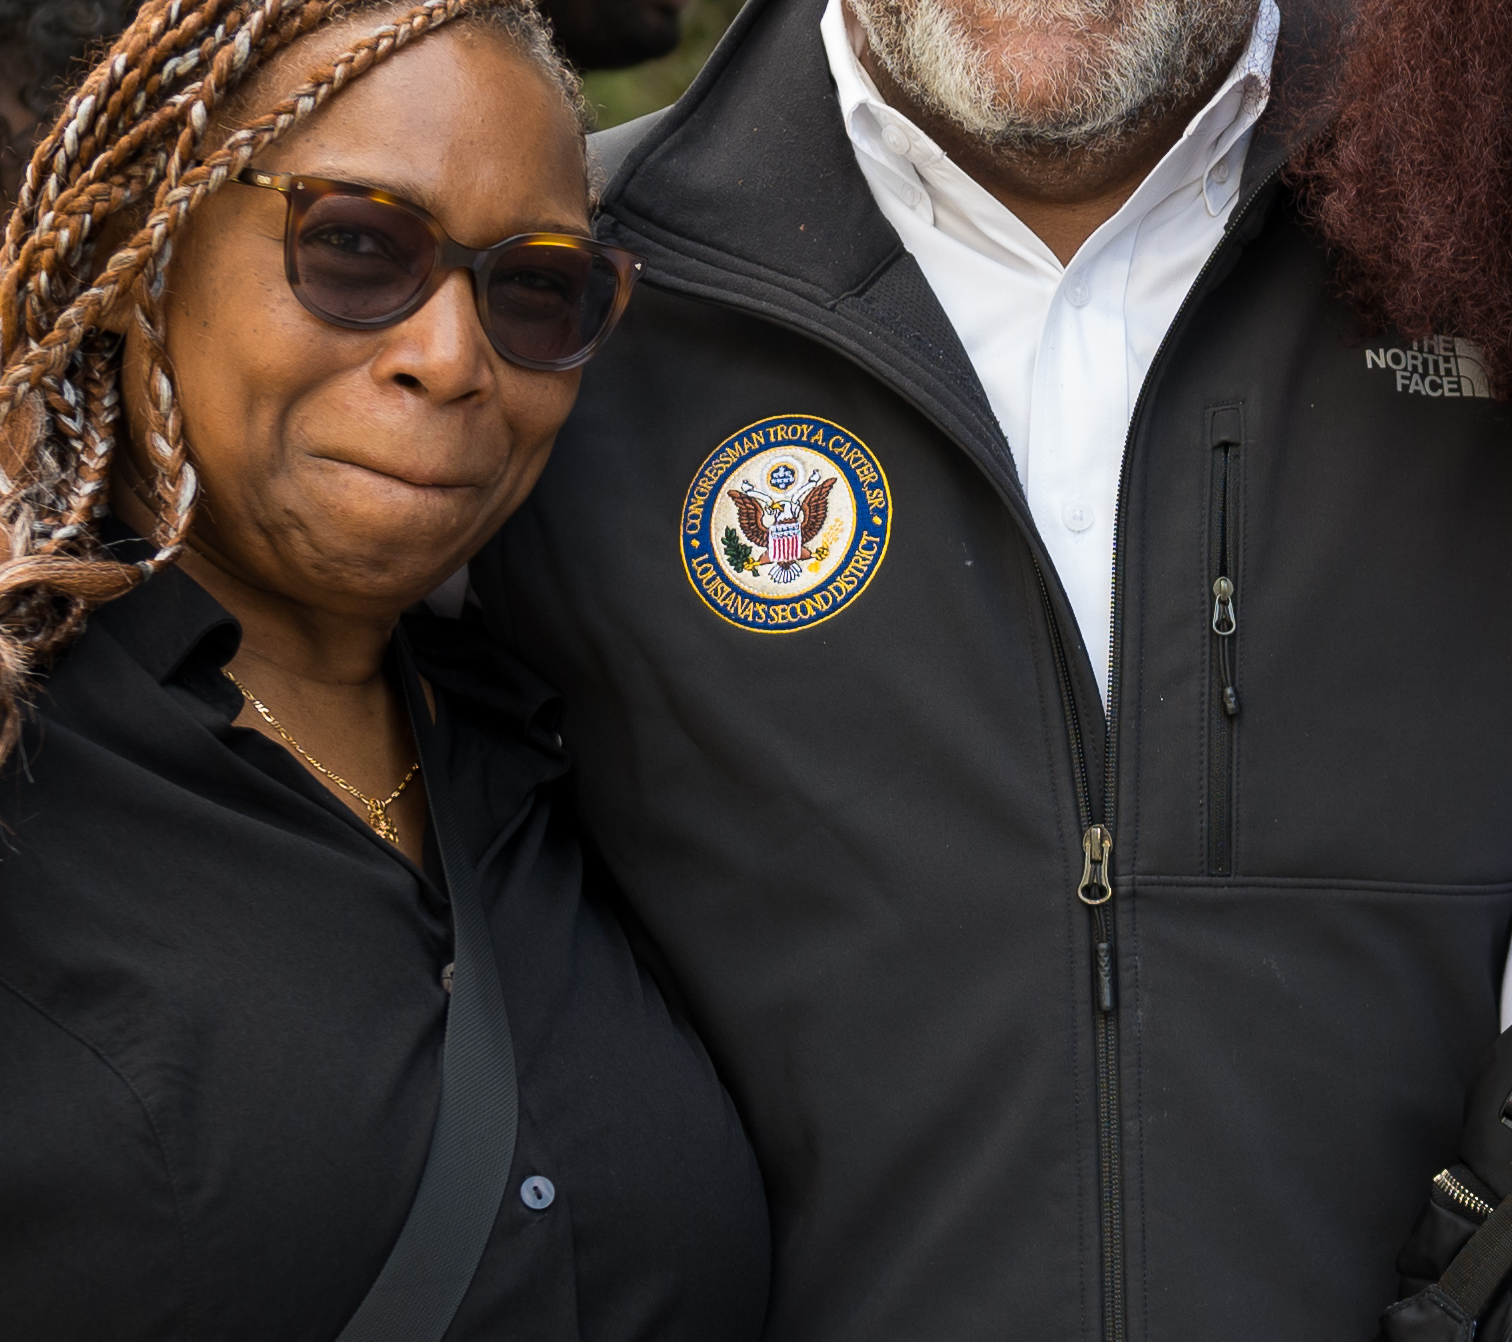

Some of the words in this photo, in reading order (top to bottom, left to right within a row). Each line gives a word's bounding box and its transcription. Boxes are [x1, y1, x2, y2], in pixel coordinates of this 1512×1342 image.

[1365, 348, 1458, 376] NORTH
[1396, 370, 1460, 397] FACE
[686, 431, 764, 535] CONGRESSMAN
[767, 424, 814, 442] TROY
[810, 428, 826, 447] A.
[691, 553, 767, 622] LOUISIANA'S
[767, 590, 833, 624] SECOND
[829, 531, 881, 602] DISTRICT
